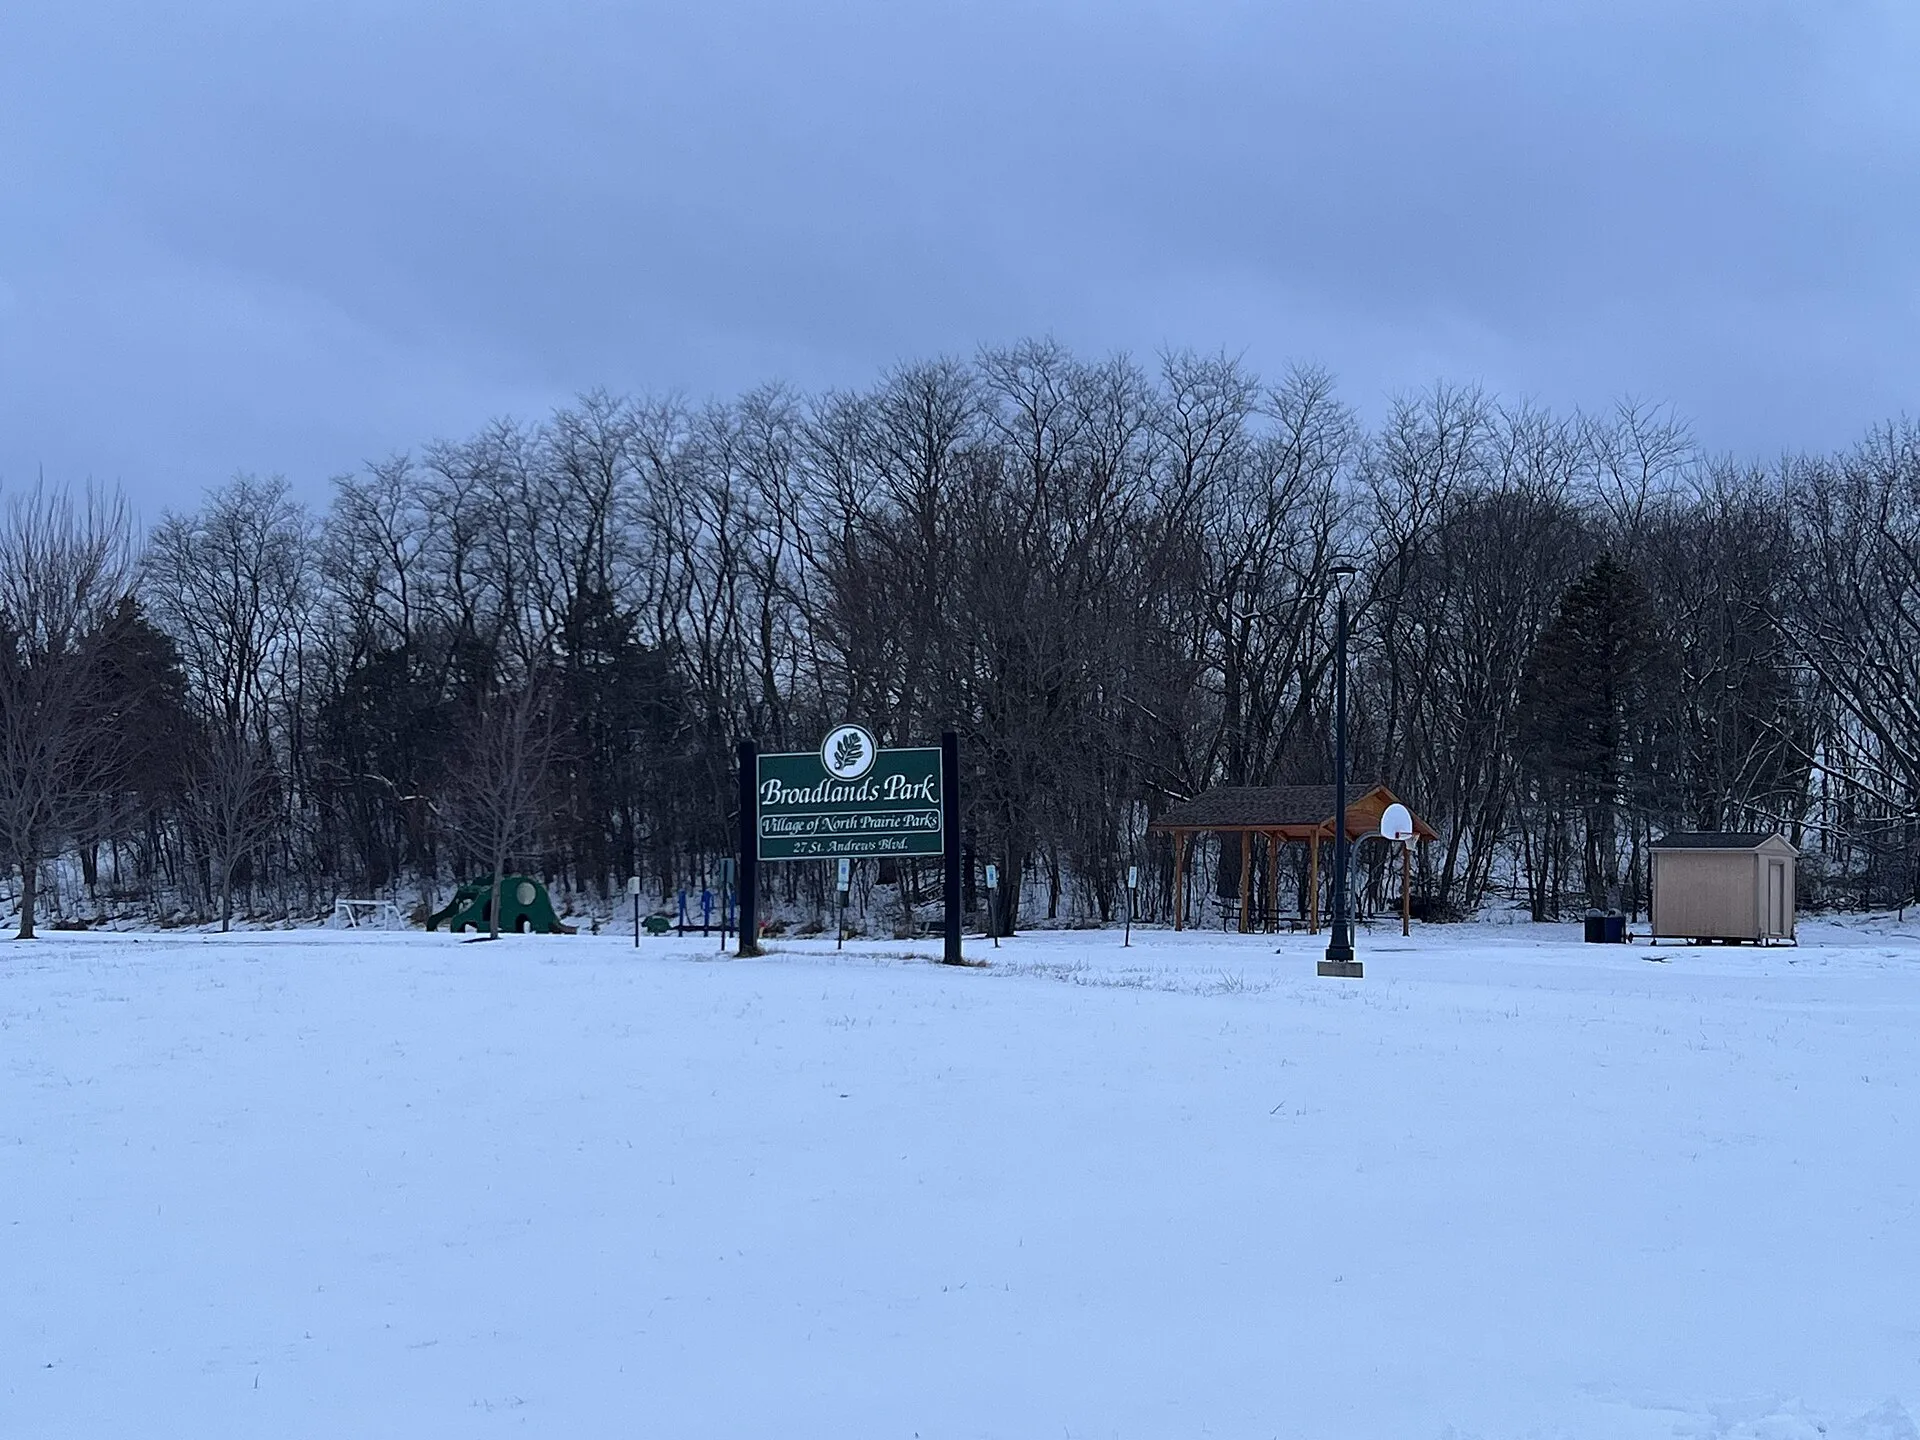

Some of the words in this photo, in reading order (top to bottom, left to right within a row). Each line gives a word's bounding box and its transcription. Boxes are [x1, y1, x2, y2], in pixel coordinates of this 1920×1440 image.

[760, 776, 880, 806] Broadlands
[883, 774, 940, 803] Park
[762, 817, 805, 836] Village
[806, 816, 822, 835] of
[822, 815, 858, 832] North
[860, 814, 901, 829] Prairie
[903, 812, 938, 829] Parks
[793, 841, 808, 853] 27
[827, 838, 877, 852] Andrews
[878, 837, 909, 850] Blvd.
